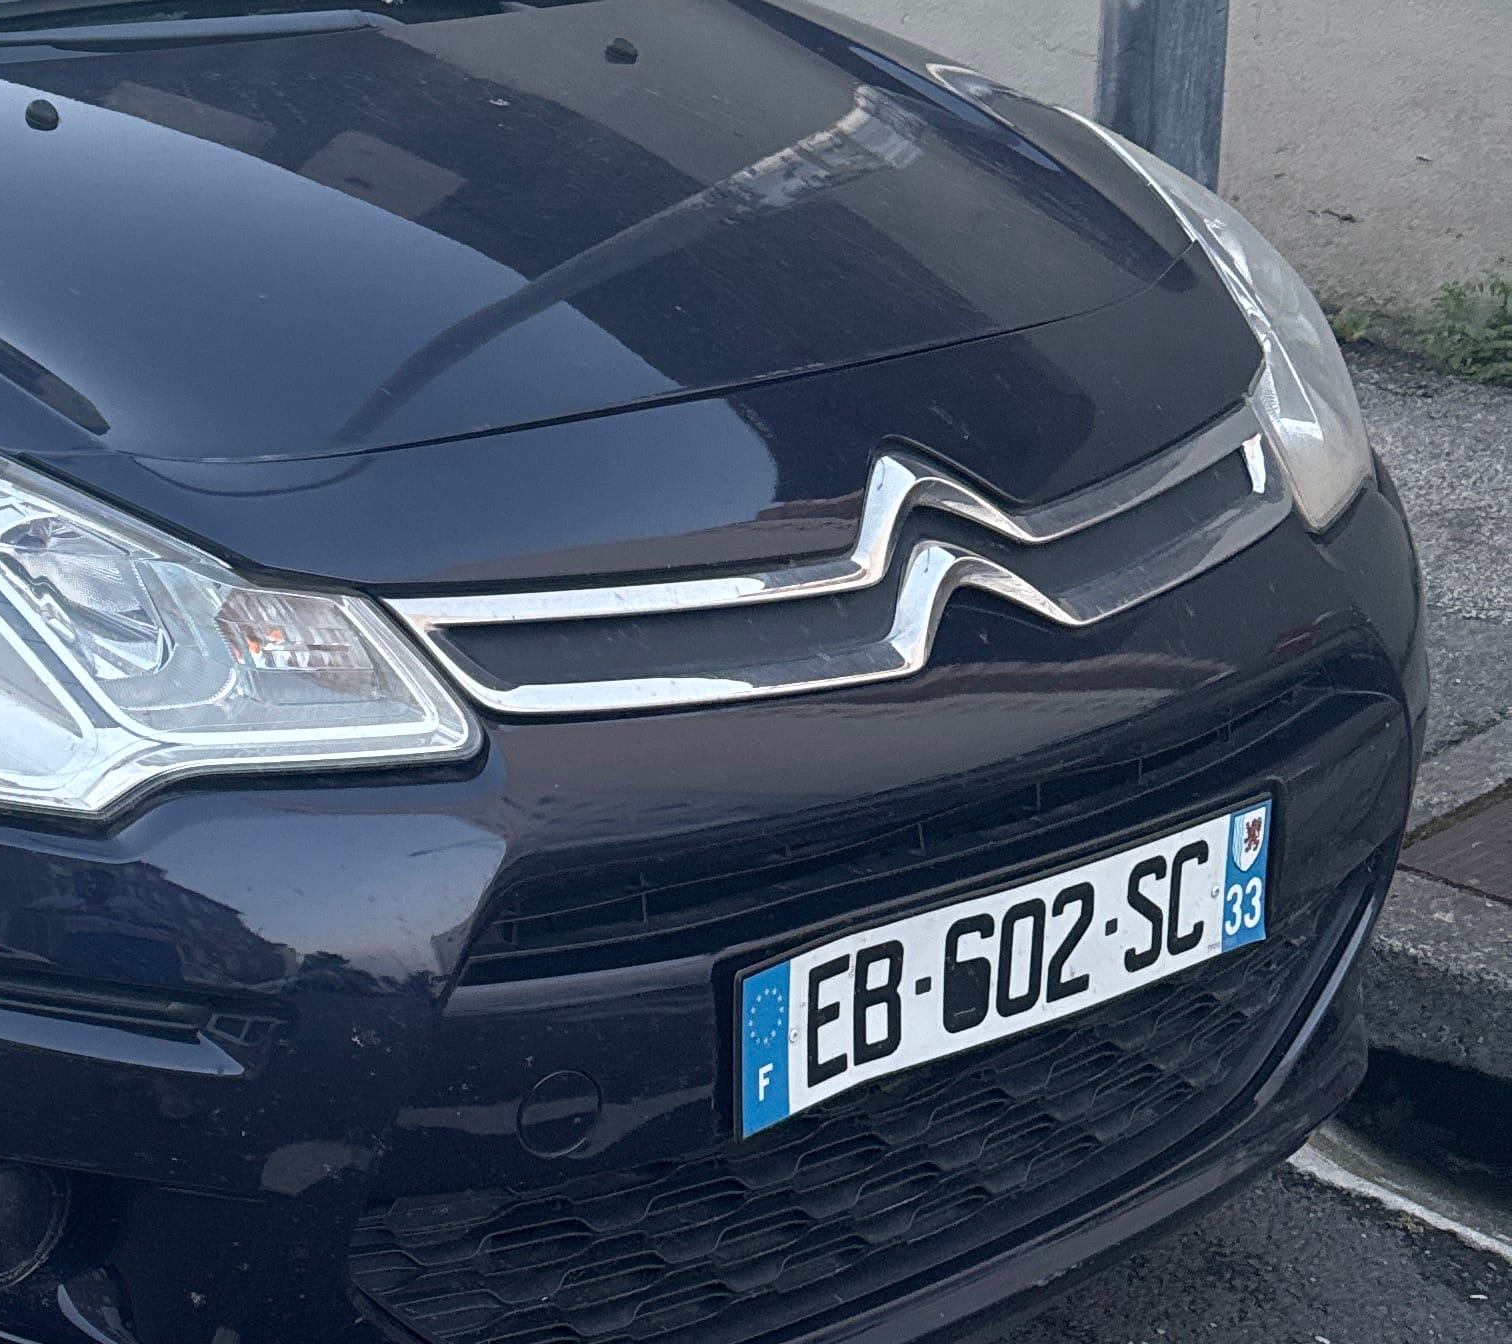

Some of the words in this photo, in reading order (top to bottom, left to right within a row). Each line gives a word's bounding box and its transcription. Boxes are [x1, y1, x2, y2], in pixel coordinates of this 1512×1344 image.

[1225, 876, 1263, 936] 33
[806, 839, 1209, 1088] EB-602-SC
[758, 1063, 774, 1102] F
